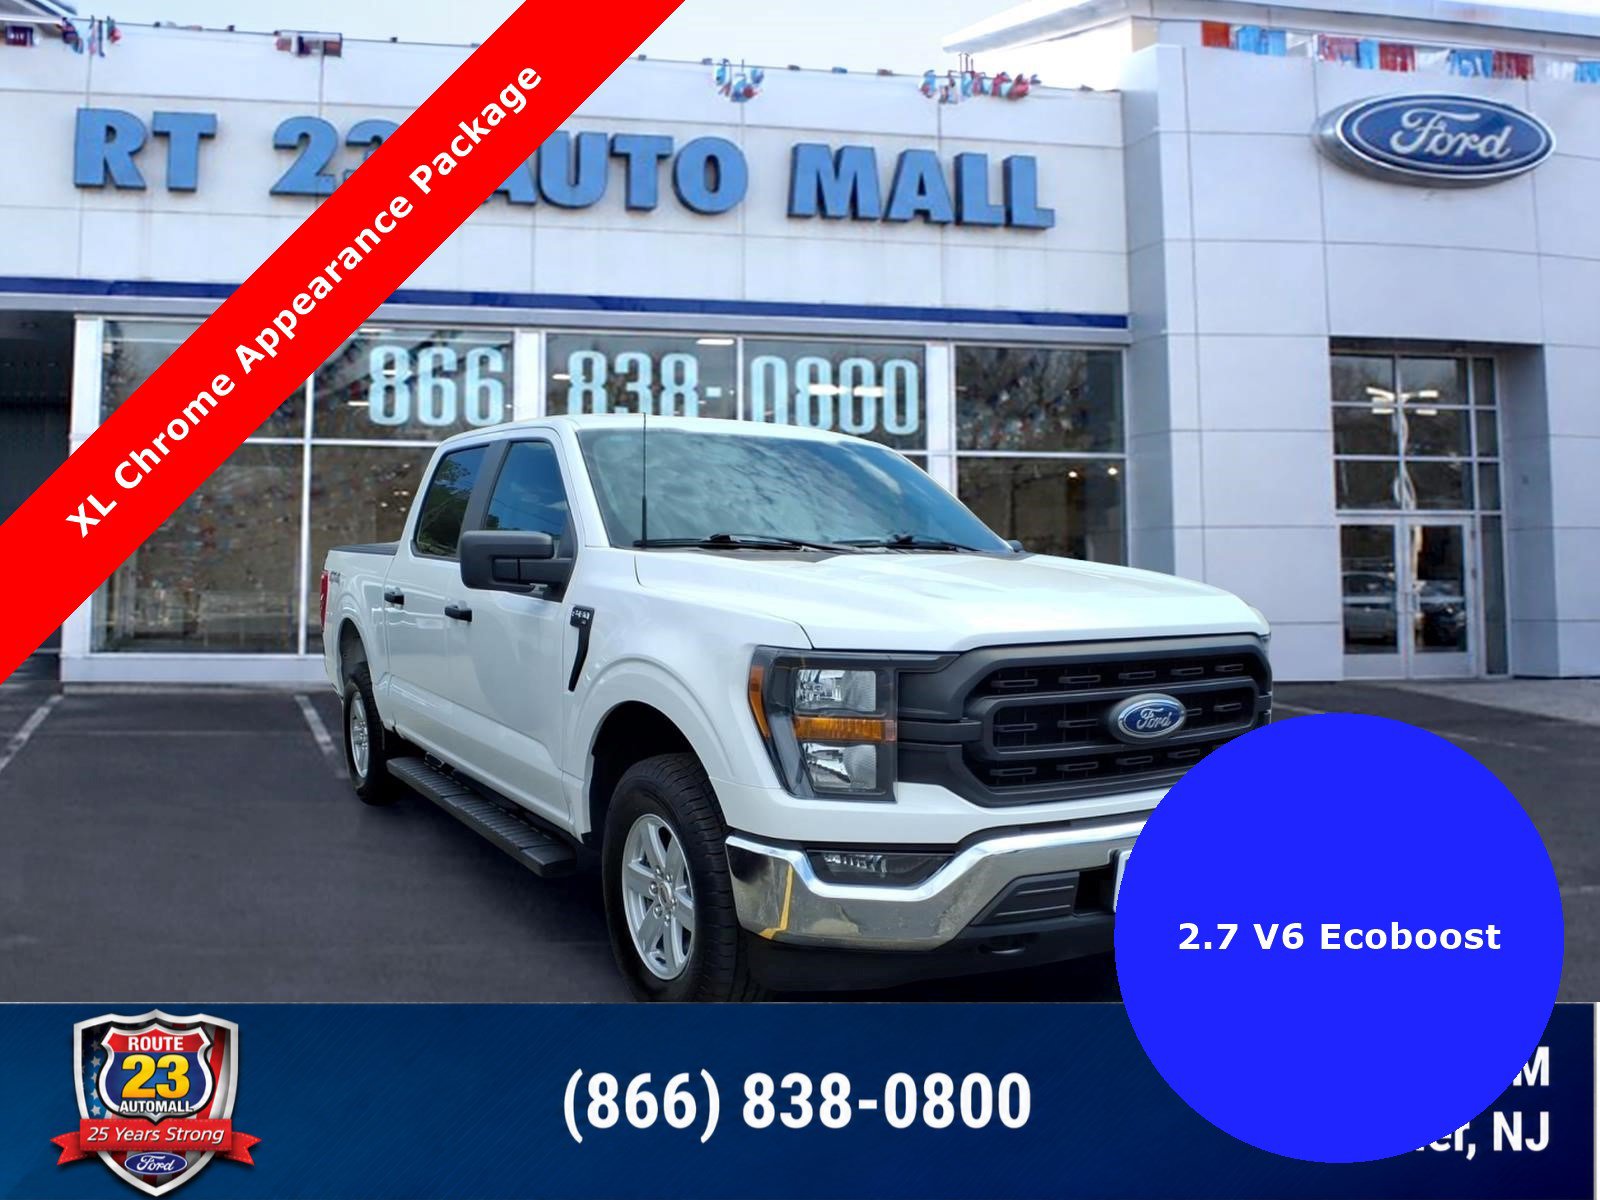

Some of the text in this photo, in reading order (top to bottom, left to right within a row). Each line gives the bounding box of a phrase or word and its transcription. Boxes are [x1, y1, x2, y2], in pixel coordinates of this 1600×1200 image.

[1390, 107, 1512, 158] Ford
[74, 108, 217, 192] RT
[787, 143, 1056, 230] MALL
[368, 345, 504, 427] 866
[1136, 707, 1173, 730] Ford
